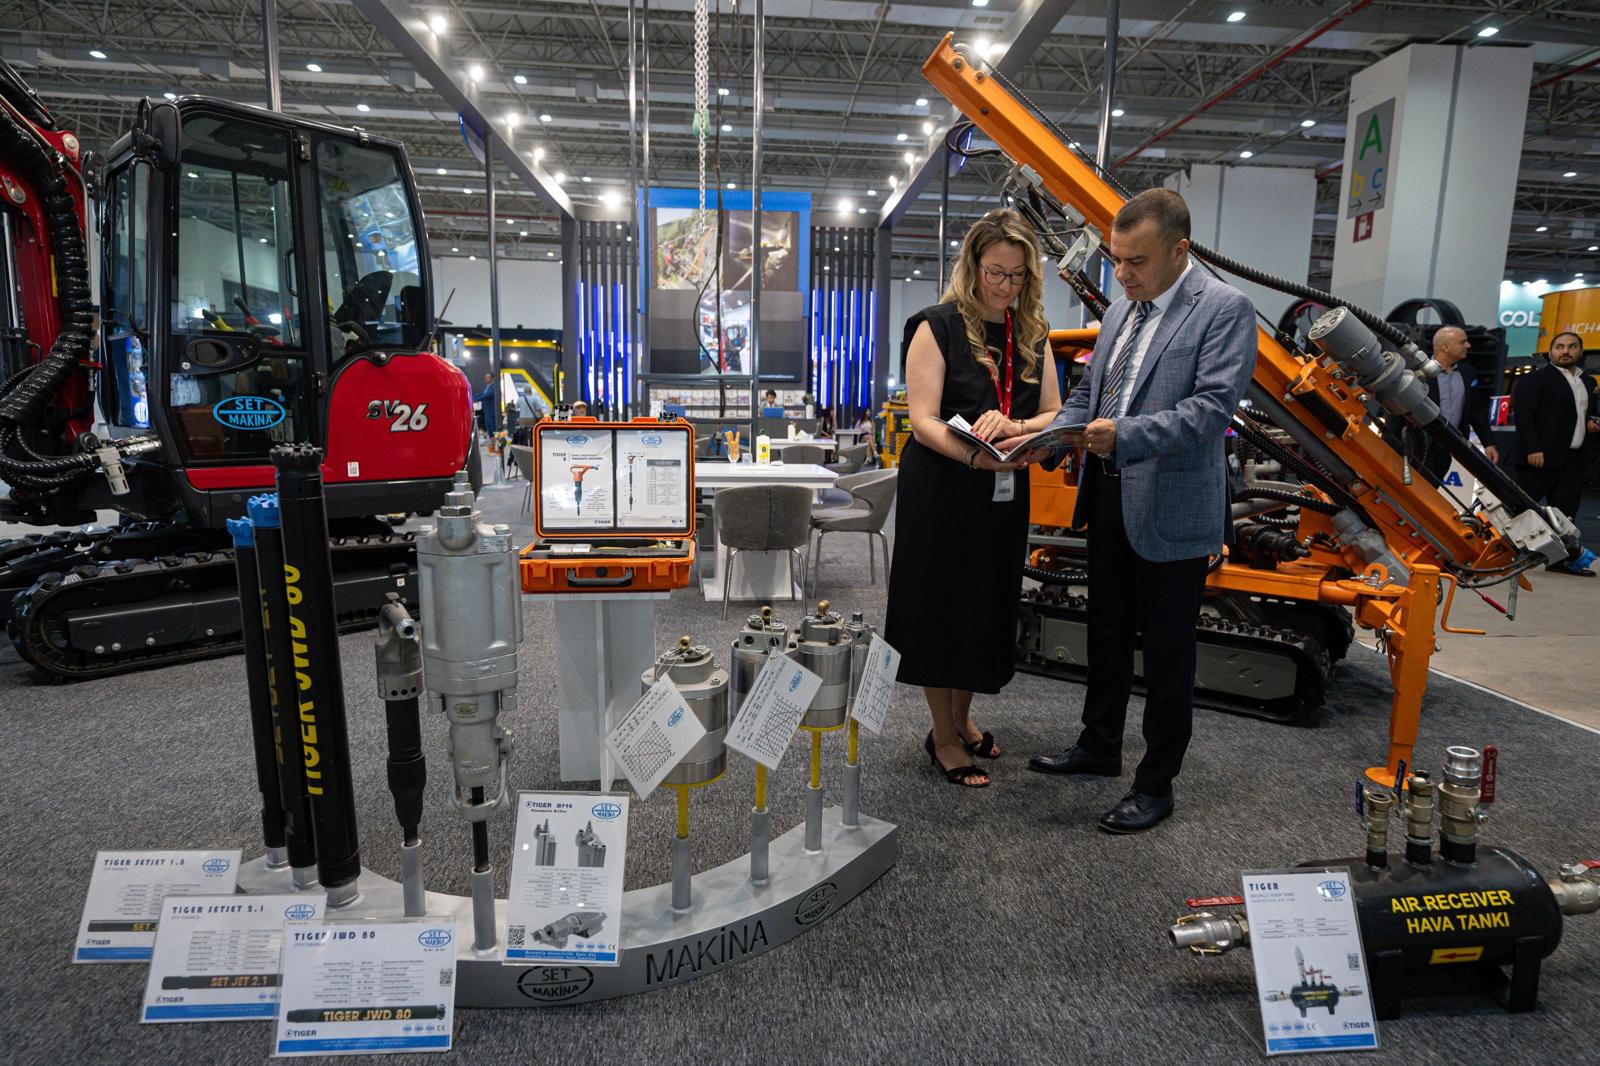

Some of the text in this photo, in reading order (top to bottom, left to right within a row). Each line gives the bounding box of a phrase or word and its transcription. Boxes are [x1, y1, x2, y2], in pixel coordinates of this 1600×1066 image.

[1359, 113, 1382, 161] A
[235, 399, 264, 410] SET
[228, 413, 273, 427] MAKİNA
[134, 858, 166, 866] SETJET
[1249, 882, 1279, 890] TIGER
[1391, 890, 1515, 913] AIR RECEIVER
[172, 906, 203, 914] TIGER
[207, 905, 242, 913] SETJET
[1406, 911, 1510, 934] HAVA TANKI
[646, 920, 769, 985] MAKİNA
[210, 976, 268, 987] SET JET 2.1
[541, 969, 569, 982] SET
[532, 982, 581, 998] MAKİNA
[323, 1008, 412, 1022] TIGER JWD 80
